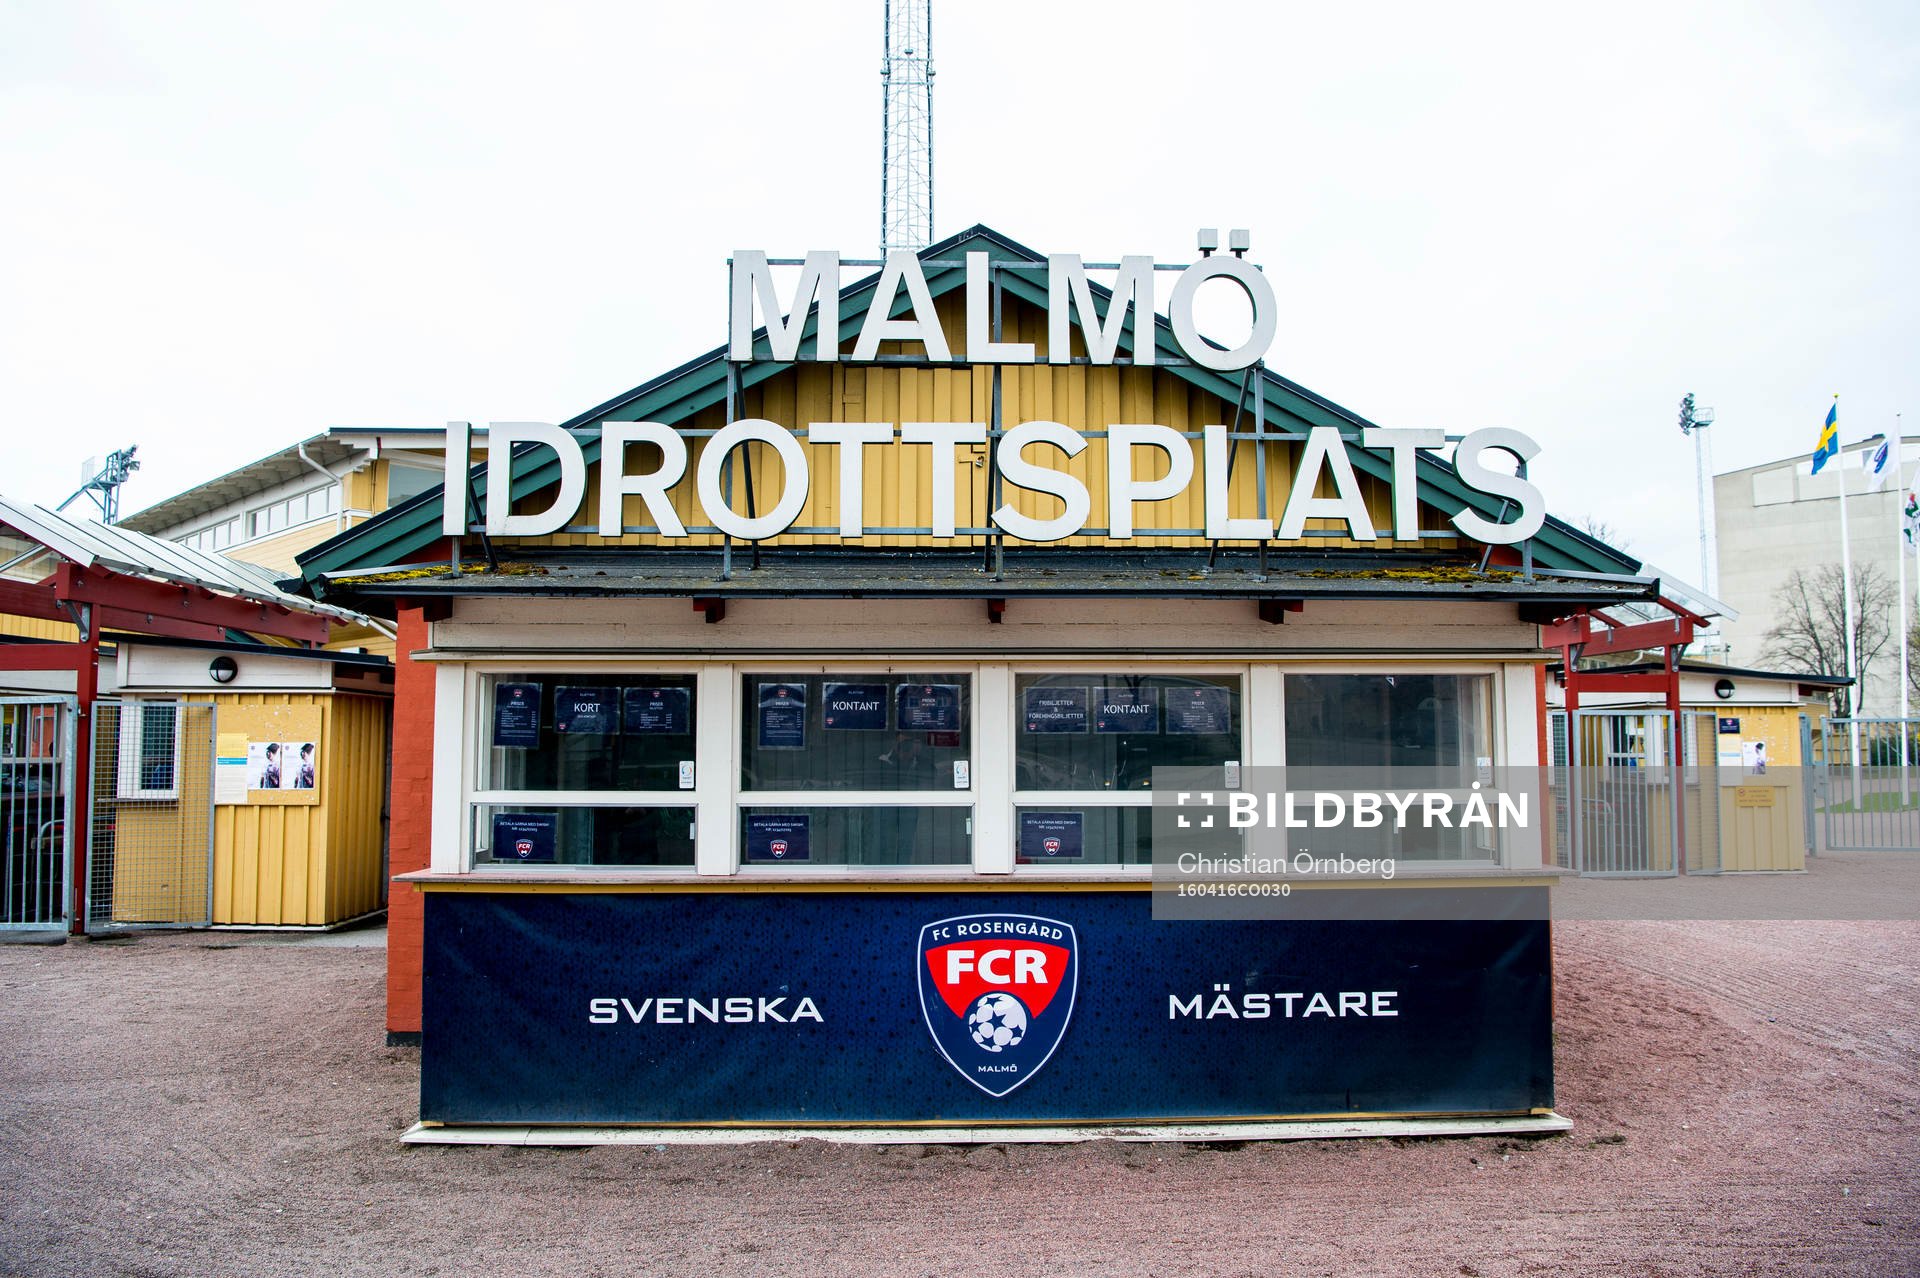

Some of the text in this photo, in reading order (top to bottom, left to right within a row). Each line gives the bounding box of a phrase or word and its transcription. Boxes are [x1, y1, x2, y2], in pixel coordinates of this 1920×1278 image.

[730, 228, 1277, 372] MALMÖ
[442, 418, 1546, 545] IDROTTSPLATS
[574, 703, 601, 713] KORT
[832, 701, 880, 711] KONTANT
[1103, 704, 1150, 714] KONTANT
[933, 922, 1063, 941] FC ROSENGÅRD
[947, 949, 1048, 985] FCR
[589, 997, 824, 1024] SVENSKA
[1169, 984, 1399, 1020] MÄSTARE
[978, 1064, 1018, 1073] MALMÖ
